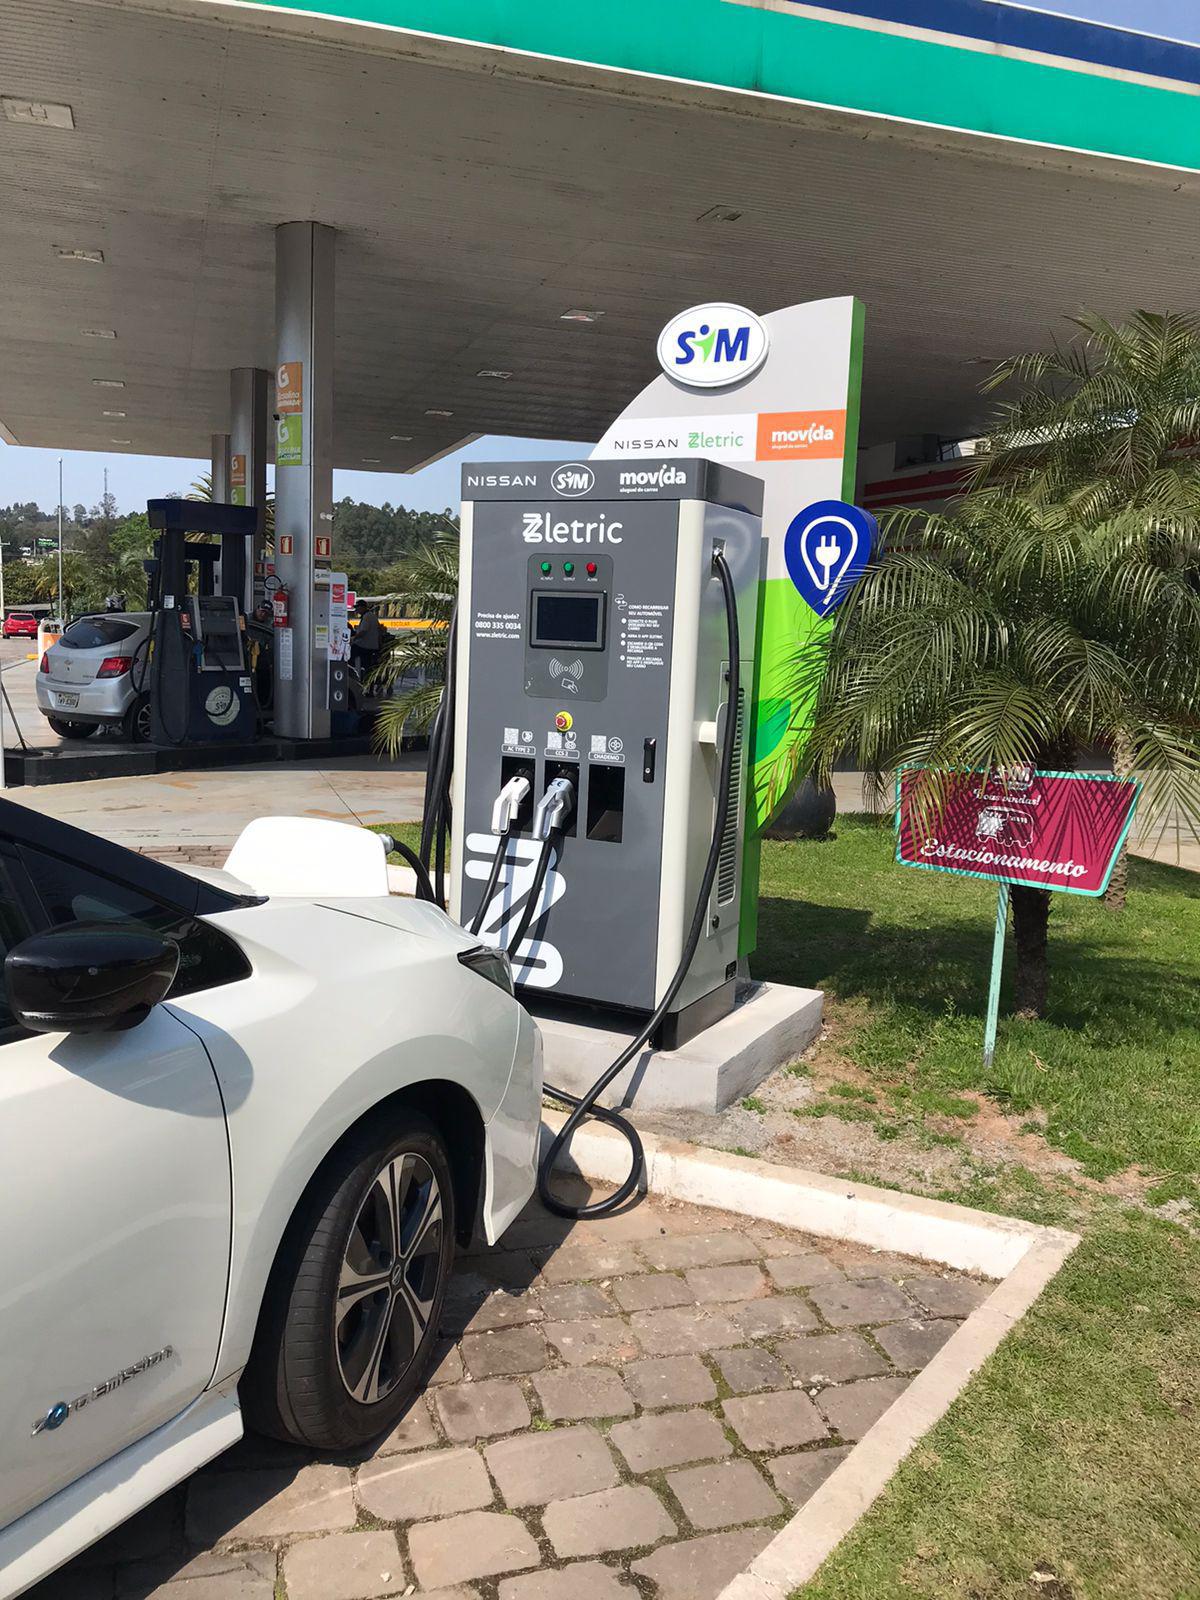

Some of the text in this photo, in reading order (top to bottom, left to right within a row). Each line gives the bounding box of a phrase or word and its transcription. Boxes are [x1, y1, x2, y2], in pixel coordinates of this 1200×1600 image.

[675, 324, 751, 365] SIM
[614, 431, 744, 450] NISSAN Zletric
[772, 422, 834, 445] movida
[467, 464, 687, 490] NISSAN SIM movida
[522, 512, 624, 544] Zletric
[475, 621, 521, 630] 0800 335 0034
[593, 753, 620, 761] CHADEMO
[920, 838, 1089, 878] Estacionamento
